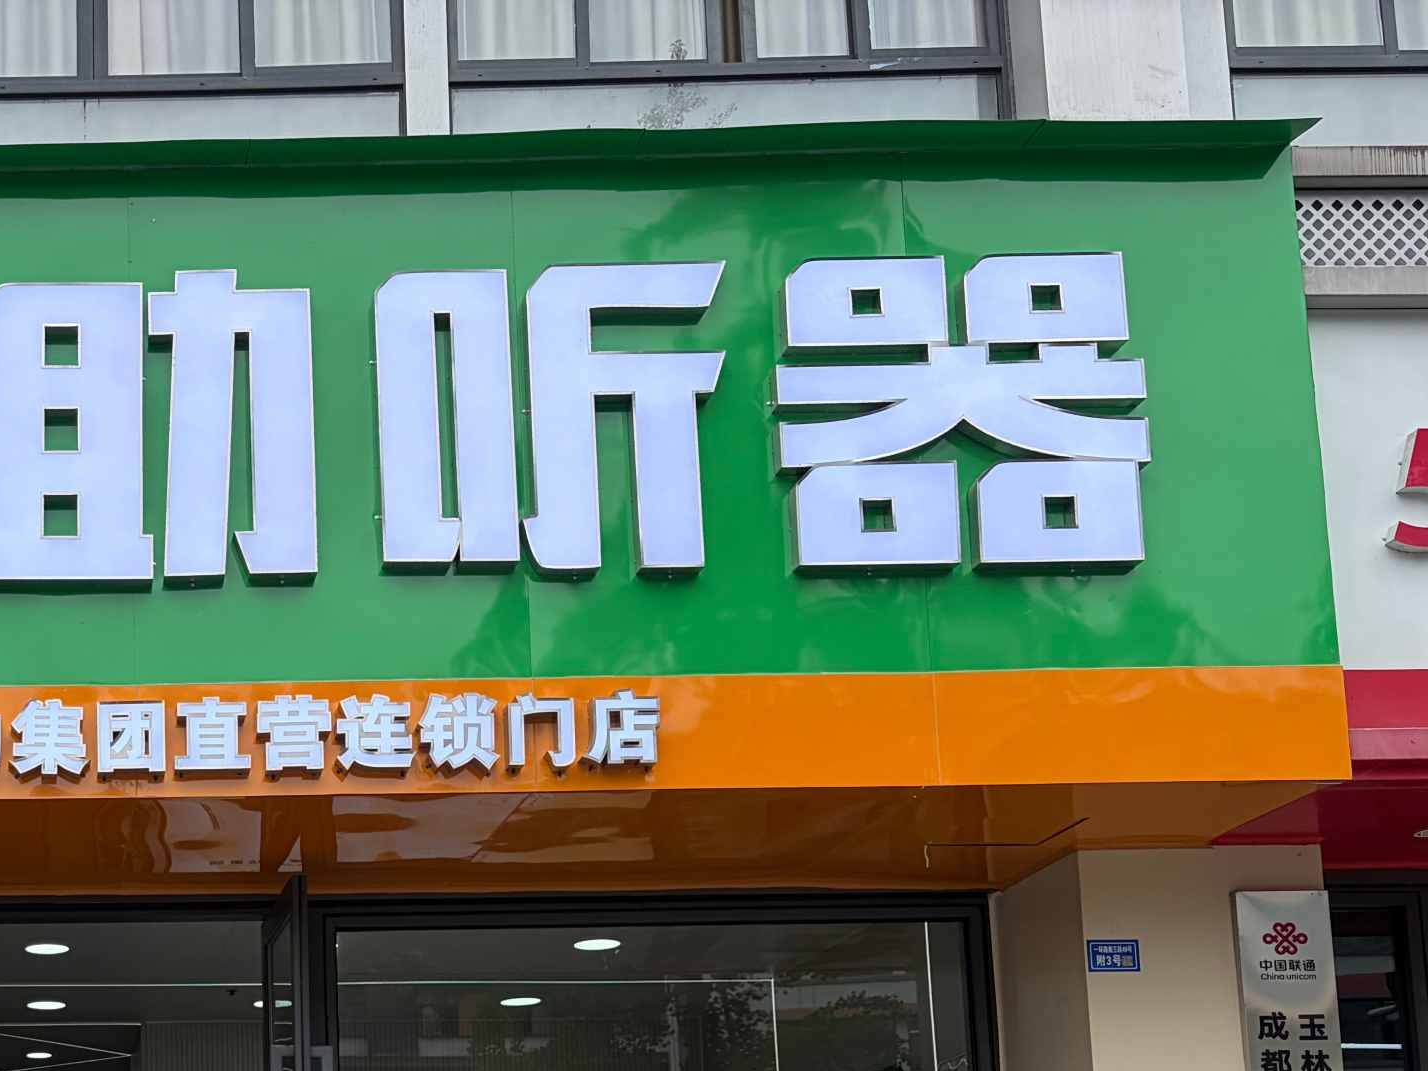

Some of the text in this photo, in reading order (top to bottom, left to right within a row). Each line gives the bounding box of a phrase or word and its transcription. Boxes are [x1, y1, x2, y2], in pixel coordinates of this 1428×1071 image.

[1260, 959, 1316, 971] 中国联通
[1260, 972, 1316, 980] China unicom
